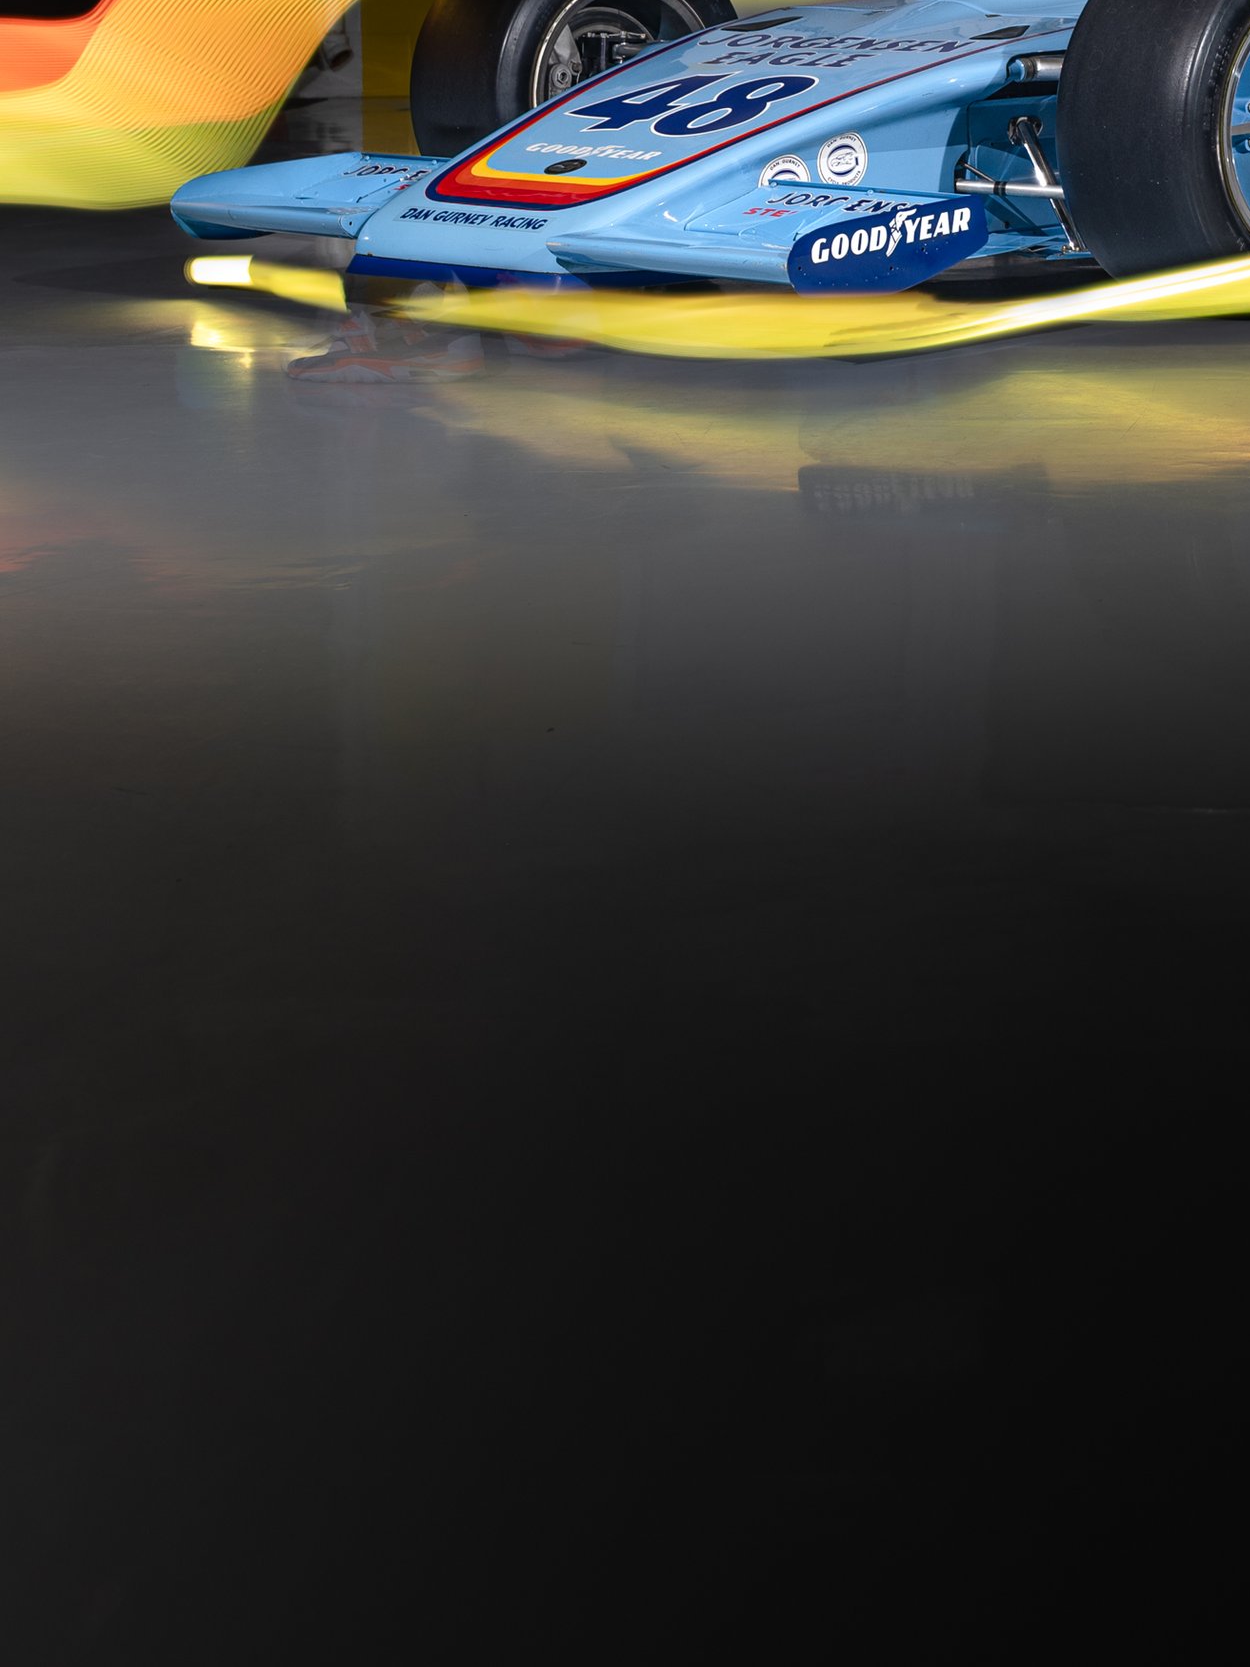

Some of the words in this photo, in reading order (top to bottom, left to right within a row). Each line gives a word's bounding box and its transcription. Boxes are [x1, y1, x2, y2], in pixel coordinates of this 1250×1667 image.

[697, 33, 976, 53] JORGENSEN
[701, 51, 875, 68] EAGLE
[564, 70, 820, 138] 48
[527, 142, 662, 160] GOODYEAR
[400, 208, 436, 221] DAN
[432, 210, 495, 225] GURNEY
[490, 215, 549, 231] RACING
[811, 207, 972, 257] GOODYEAR
